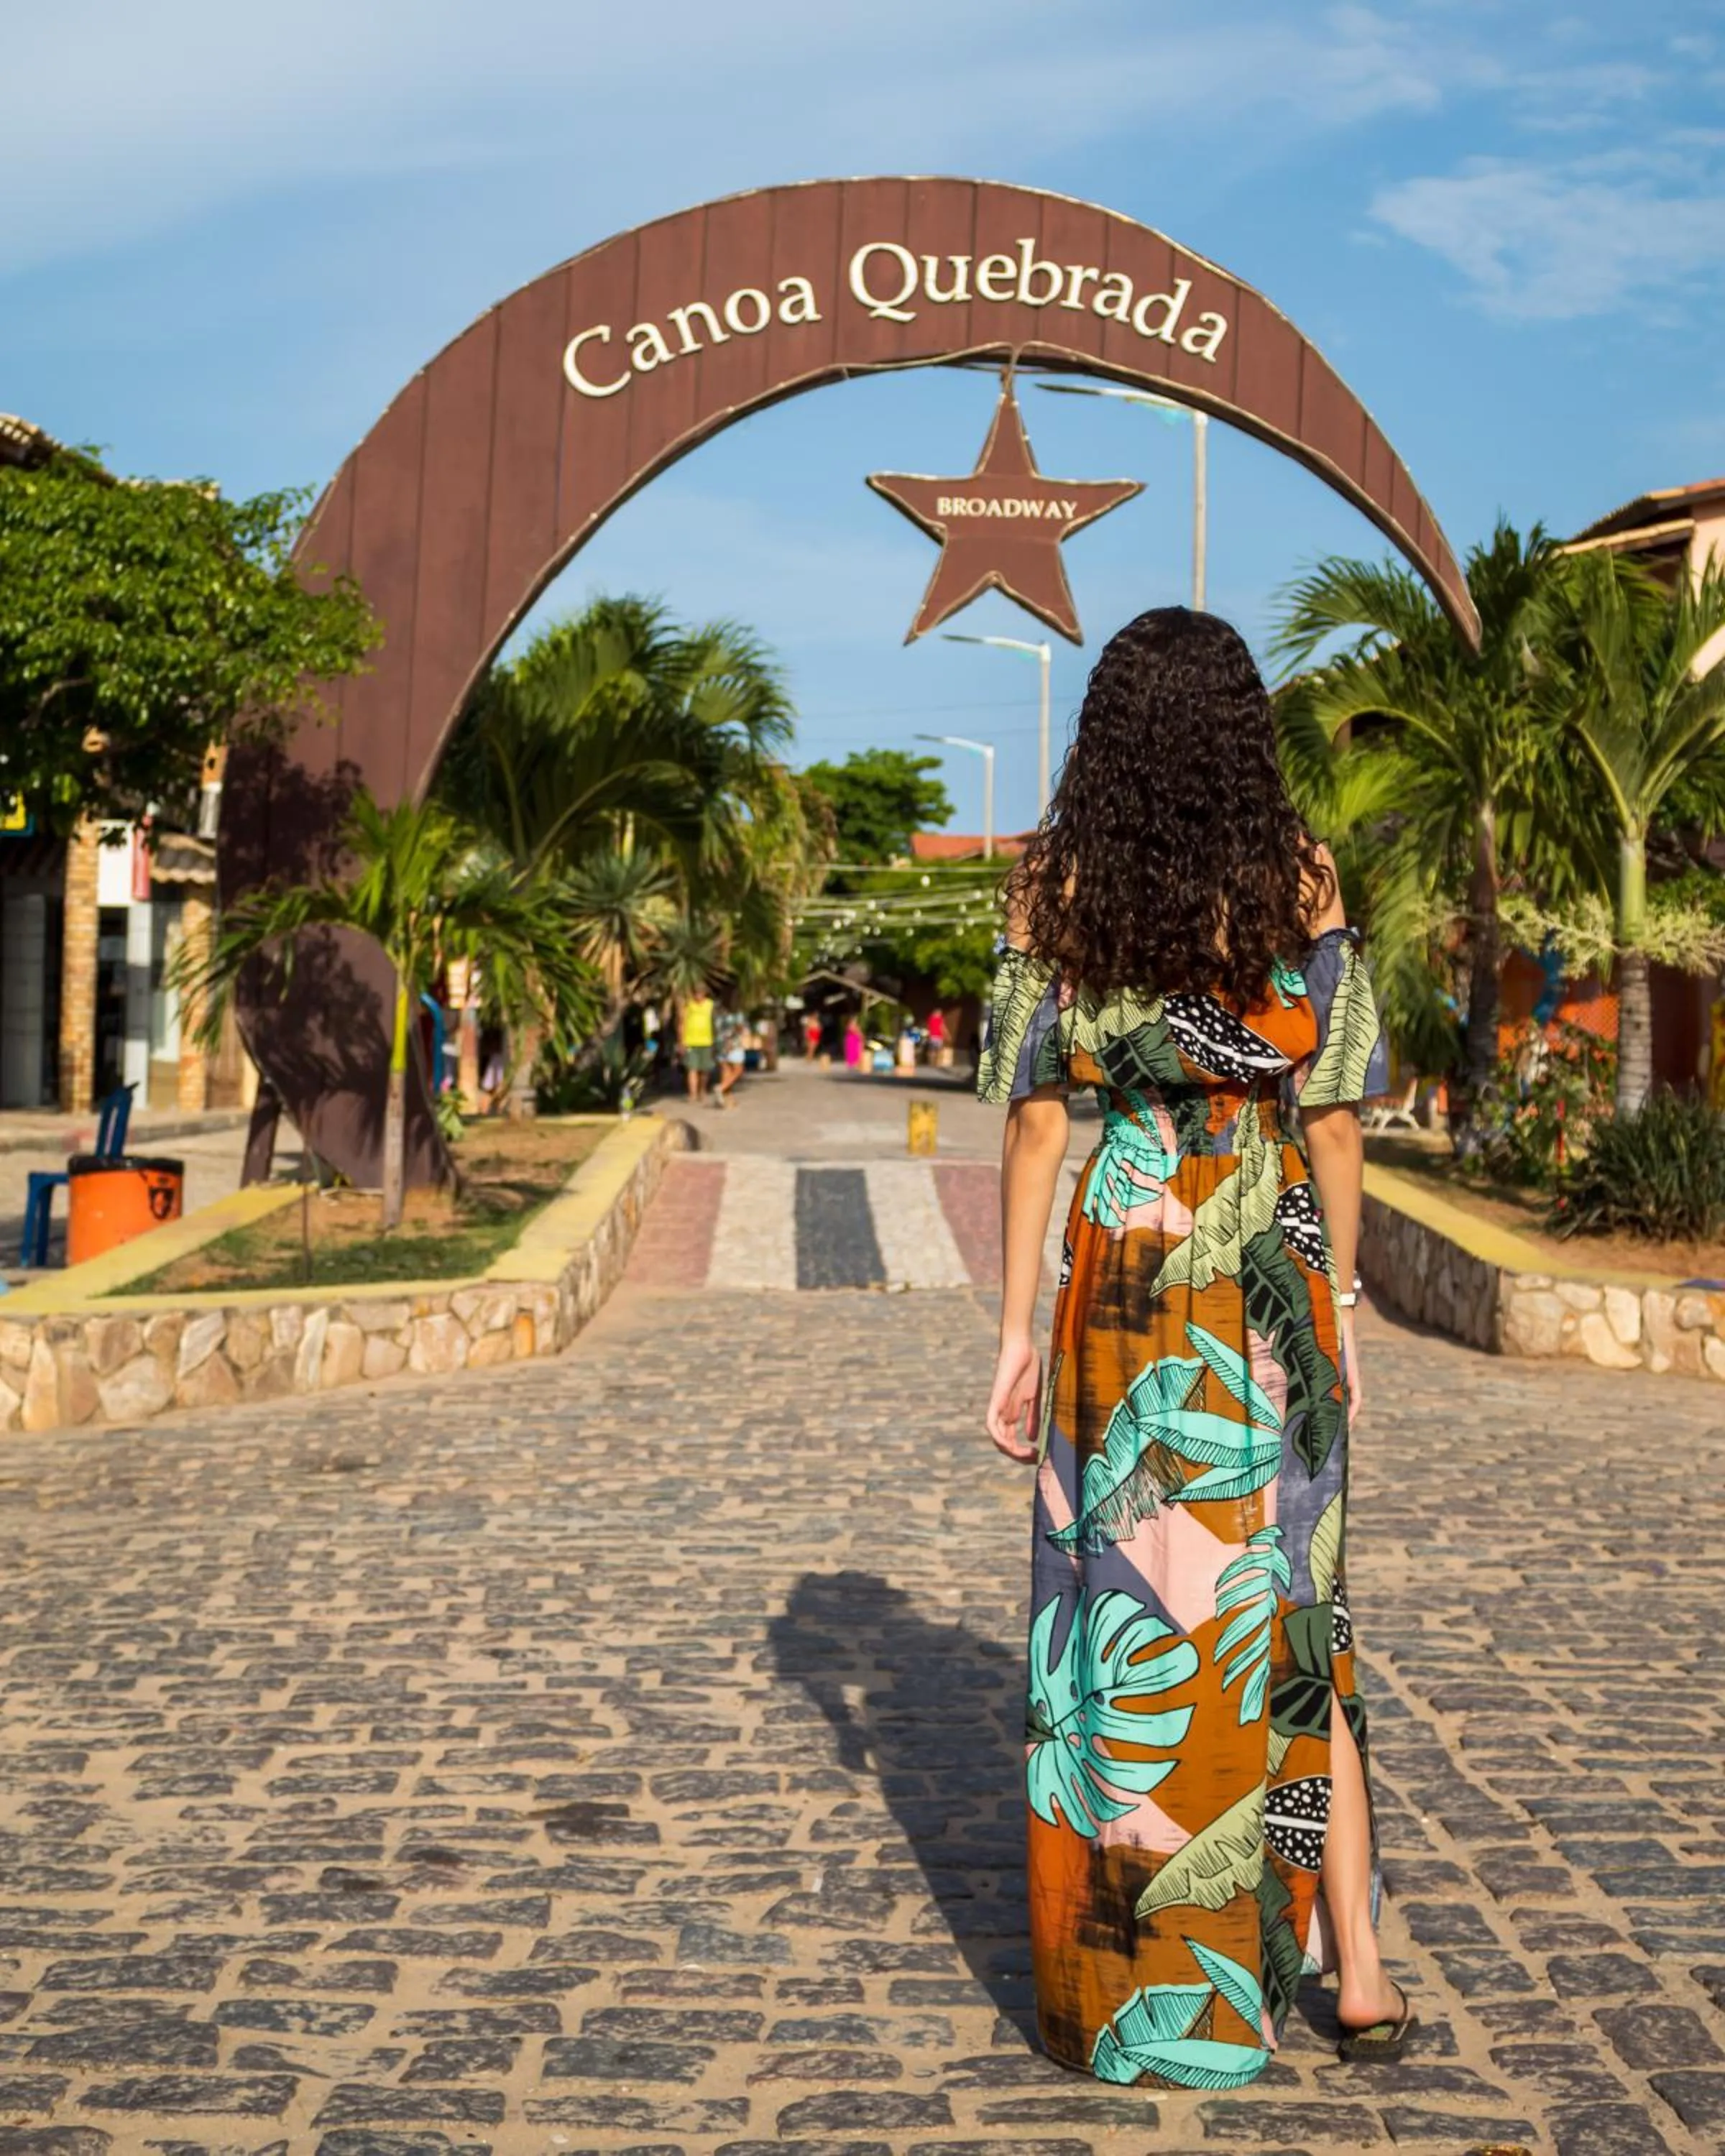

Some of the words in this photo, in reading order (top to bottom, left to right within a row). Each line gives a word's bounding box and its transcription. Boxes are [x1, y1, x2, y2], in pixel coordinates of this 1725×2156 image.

[562, 275, 822, 398] Canoa
[849, 238, 1228, 362] Quebrada
[937, 497, 1077, 519] BROADWAY
